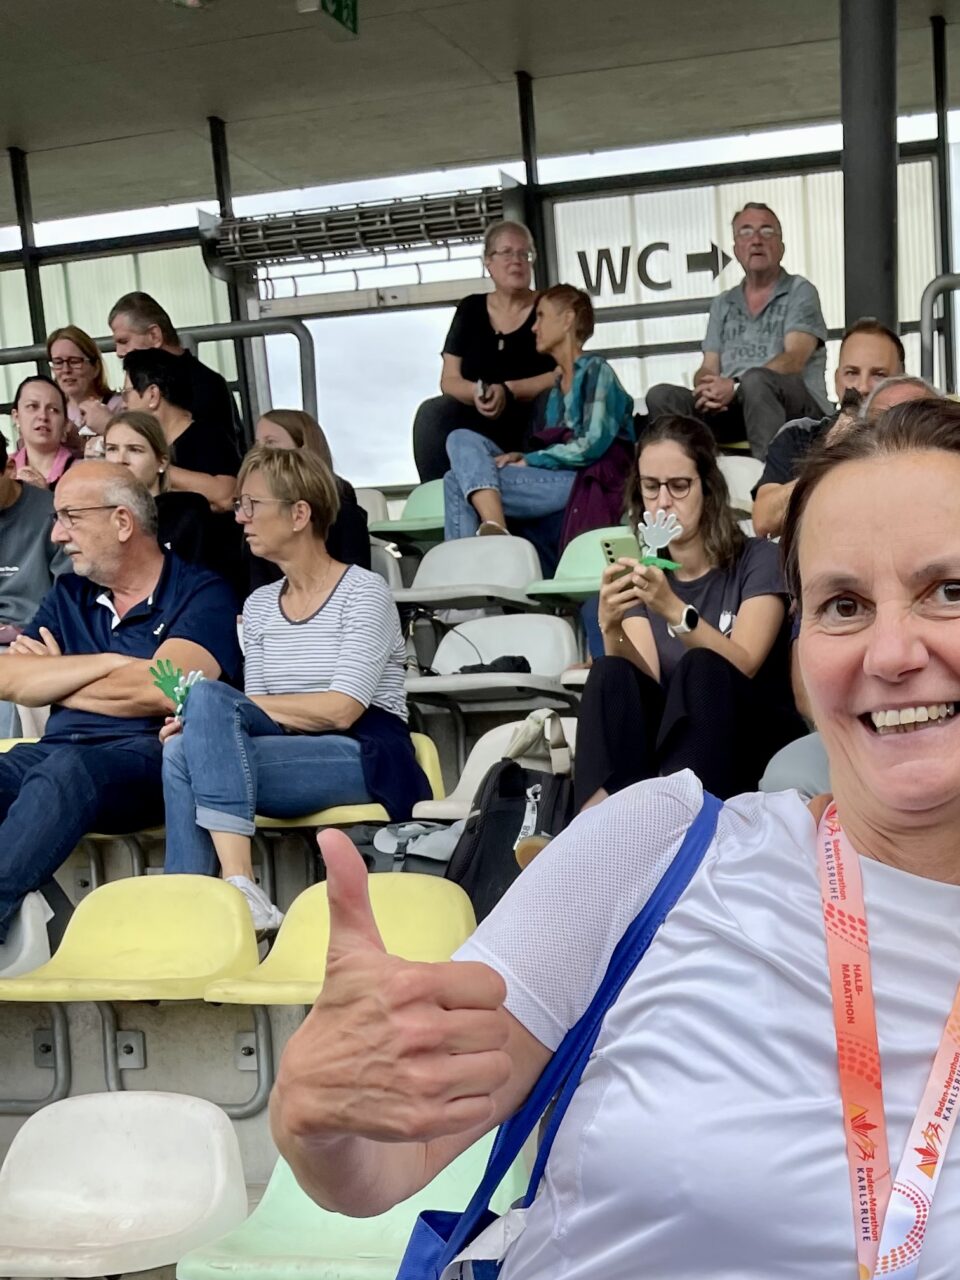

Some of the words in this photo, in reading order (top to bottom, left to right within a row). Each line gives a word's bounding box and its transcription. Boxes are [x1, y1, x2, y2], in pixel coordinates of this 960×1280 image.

[577, 241, 673, 297] WC
[824, 841, 839, 901] KARLSRUHE
[832, 838, 847, 901] Baden-Marathon
[841, 963, 855, 1025] MARATHON
[853, 963, 864, 997] HALB-
[934, 1051, 960, 1119] Baden-Marathon
[856, 1166, 872, 1243] KARLSRUHE
[865, 1166, 879, 1243] Baden-Marathon
